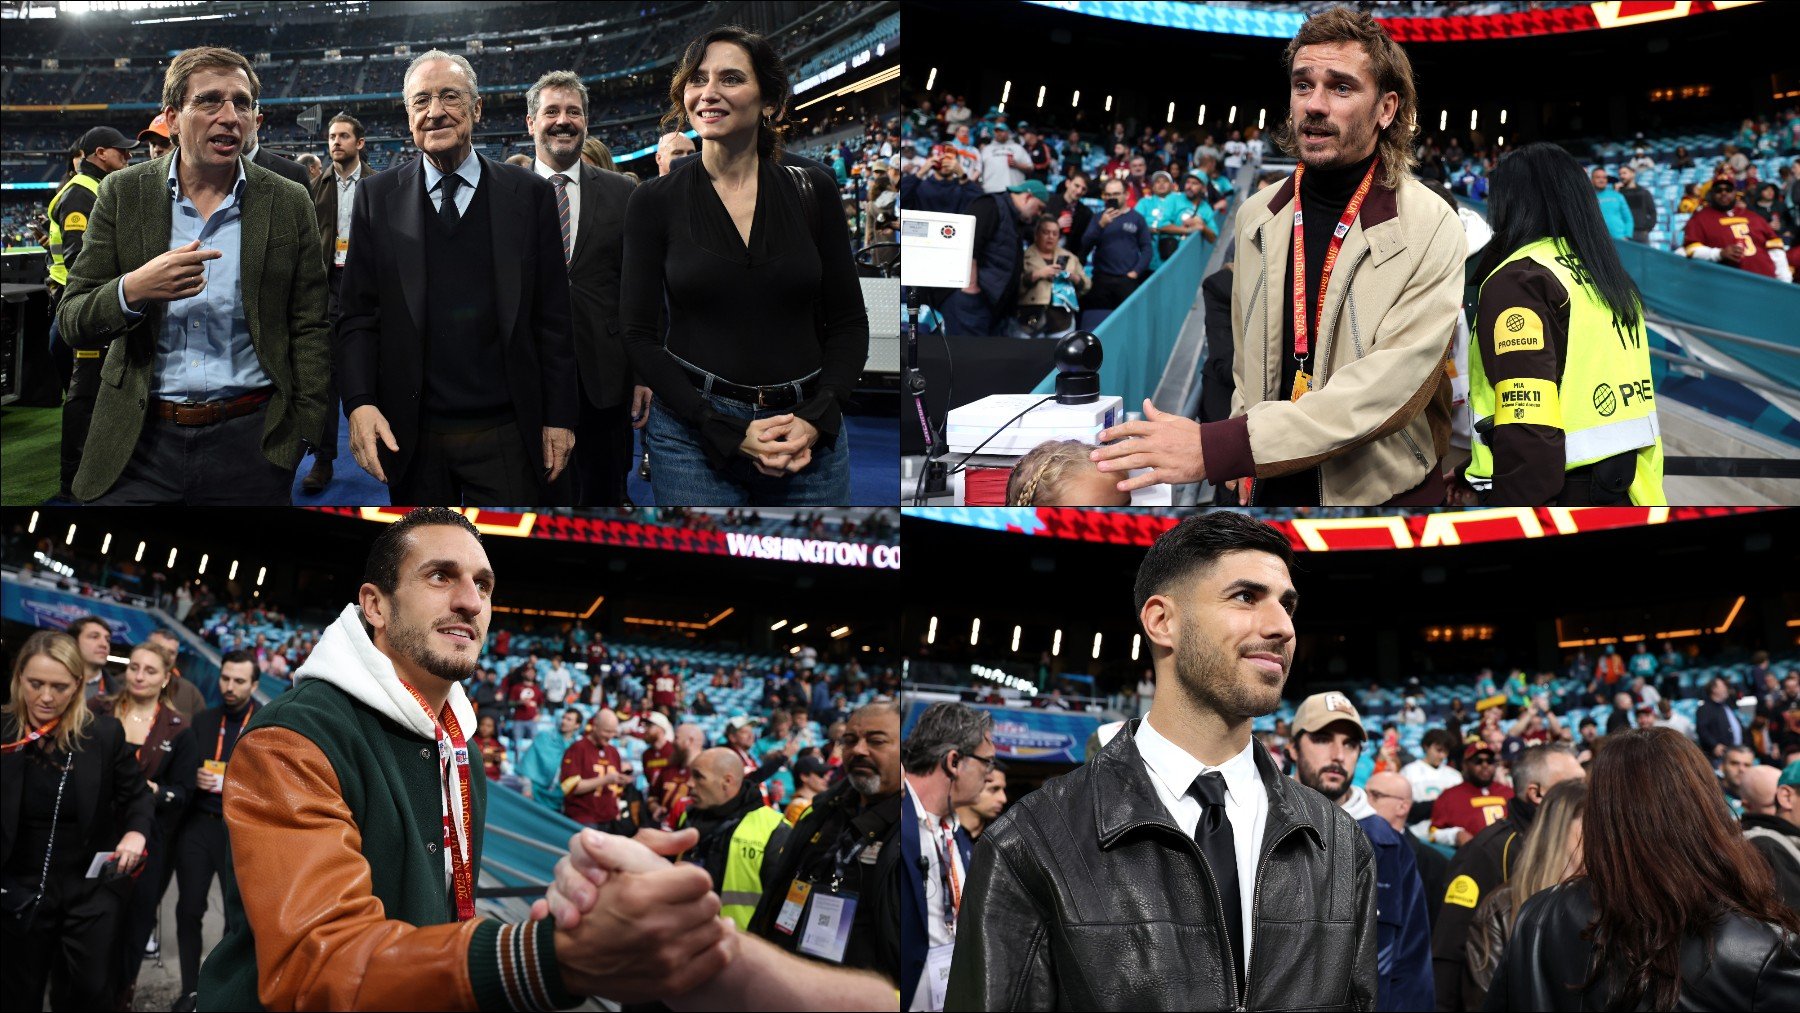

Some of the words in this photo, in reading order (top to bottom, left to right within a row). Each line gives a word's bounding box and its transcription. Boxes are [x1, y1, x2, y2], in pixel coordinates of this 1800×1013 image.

[1347, 174, 1373, 215] NOVEMBER
[1295, 236, 1304, 264] GAME
[1730, 223, 1757, 256] 5
[1324, 246, 1339, 272] GAME
[1295, 265, 1304, 296] MADRID
[1296, 297, 1304, 315] NFL
[1296, 316, 1305, 336] 2025
[1498, 338, 1538, 349] PROSEGUR
[1501, 390, 1531, 402] WEEK
[1532, 390, 1541, 402] 11
[726, 532, 868, 567] WASHINGTON
[872, 544, 900, 570] CO
[454, 852, 463, 871] NFL
[455, 873, 469, 900] 2025
